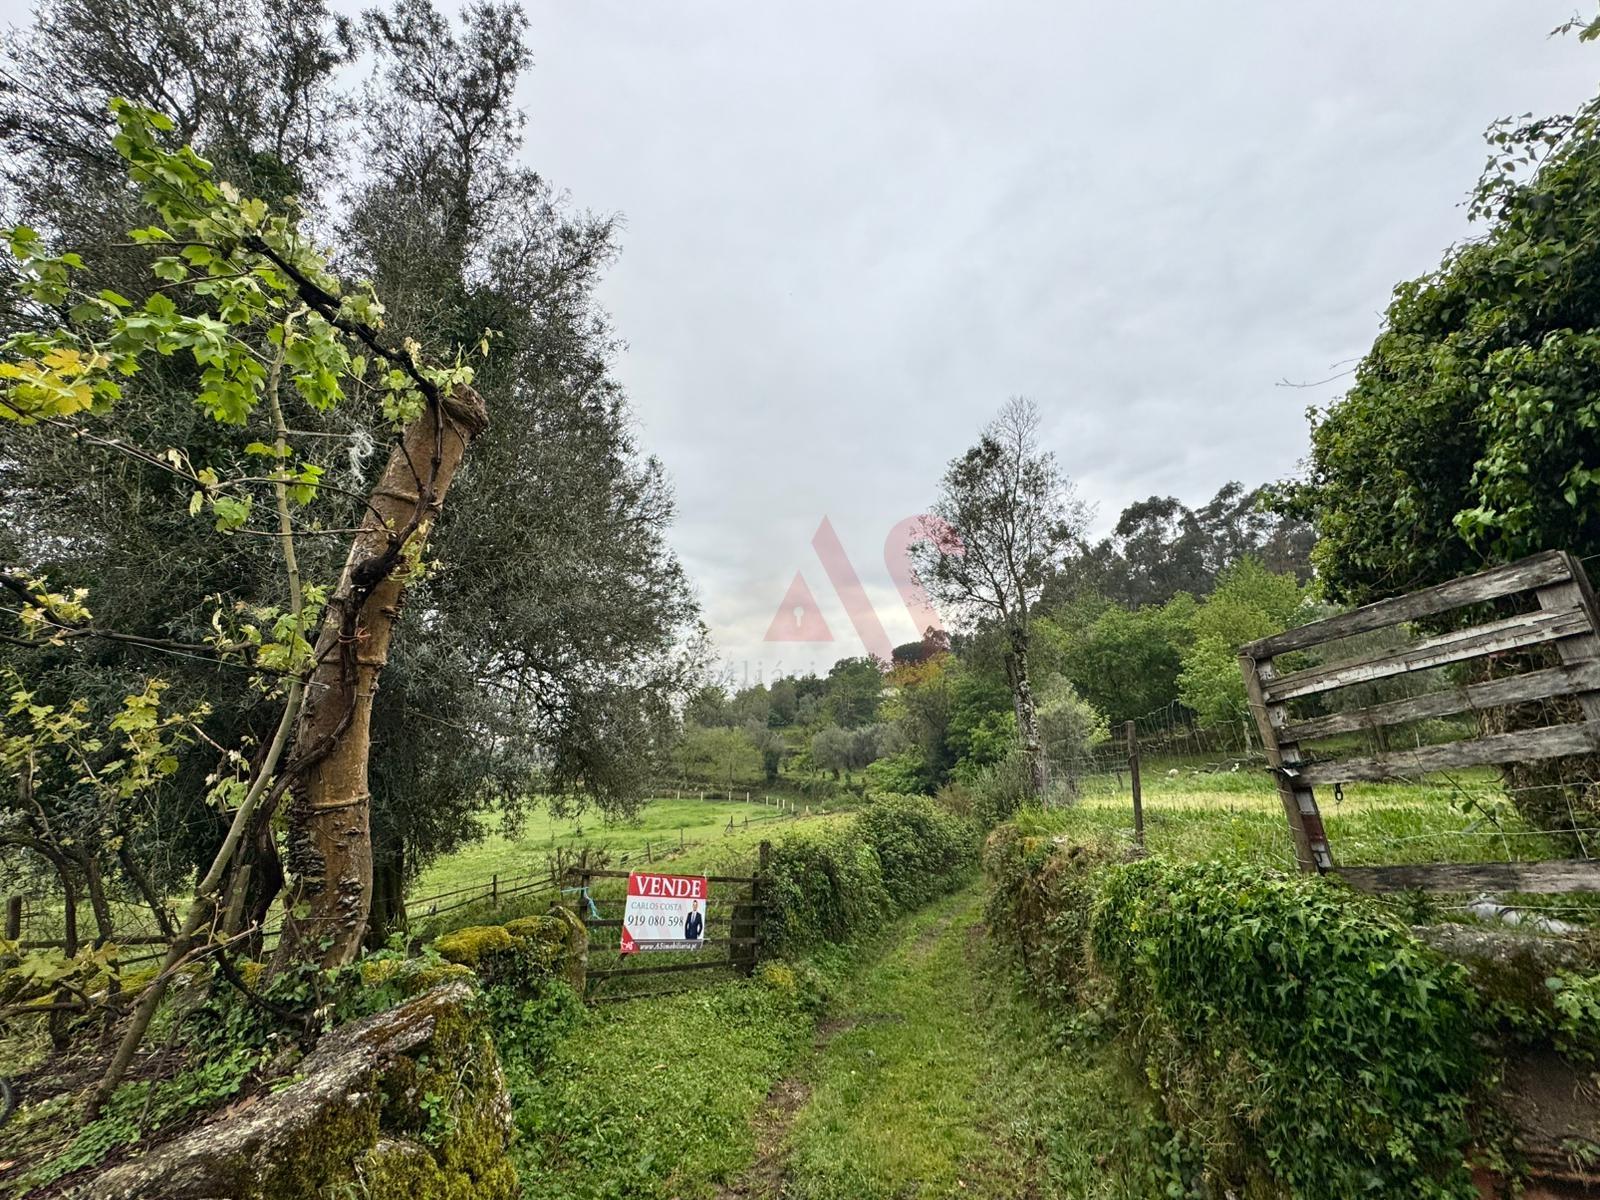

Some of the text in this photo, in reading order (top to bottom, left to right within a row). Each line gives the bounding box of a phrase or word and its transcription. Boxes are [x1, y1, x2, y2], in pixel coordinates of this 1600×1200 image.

[635, 876, 701, 897] VENDE
[631, 902, 682, 911] CARLOS COSTA
[627, 914, 683, 926] 919 080 598
